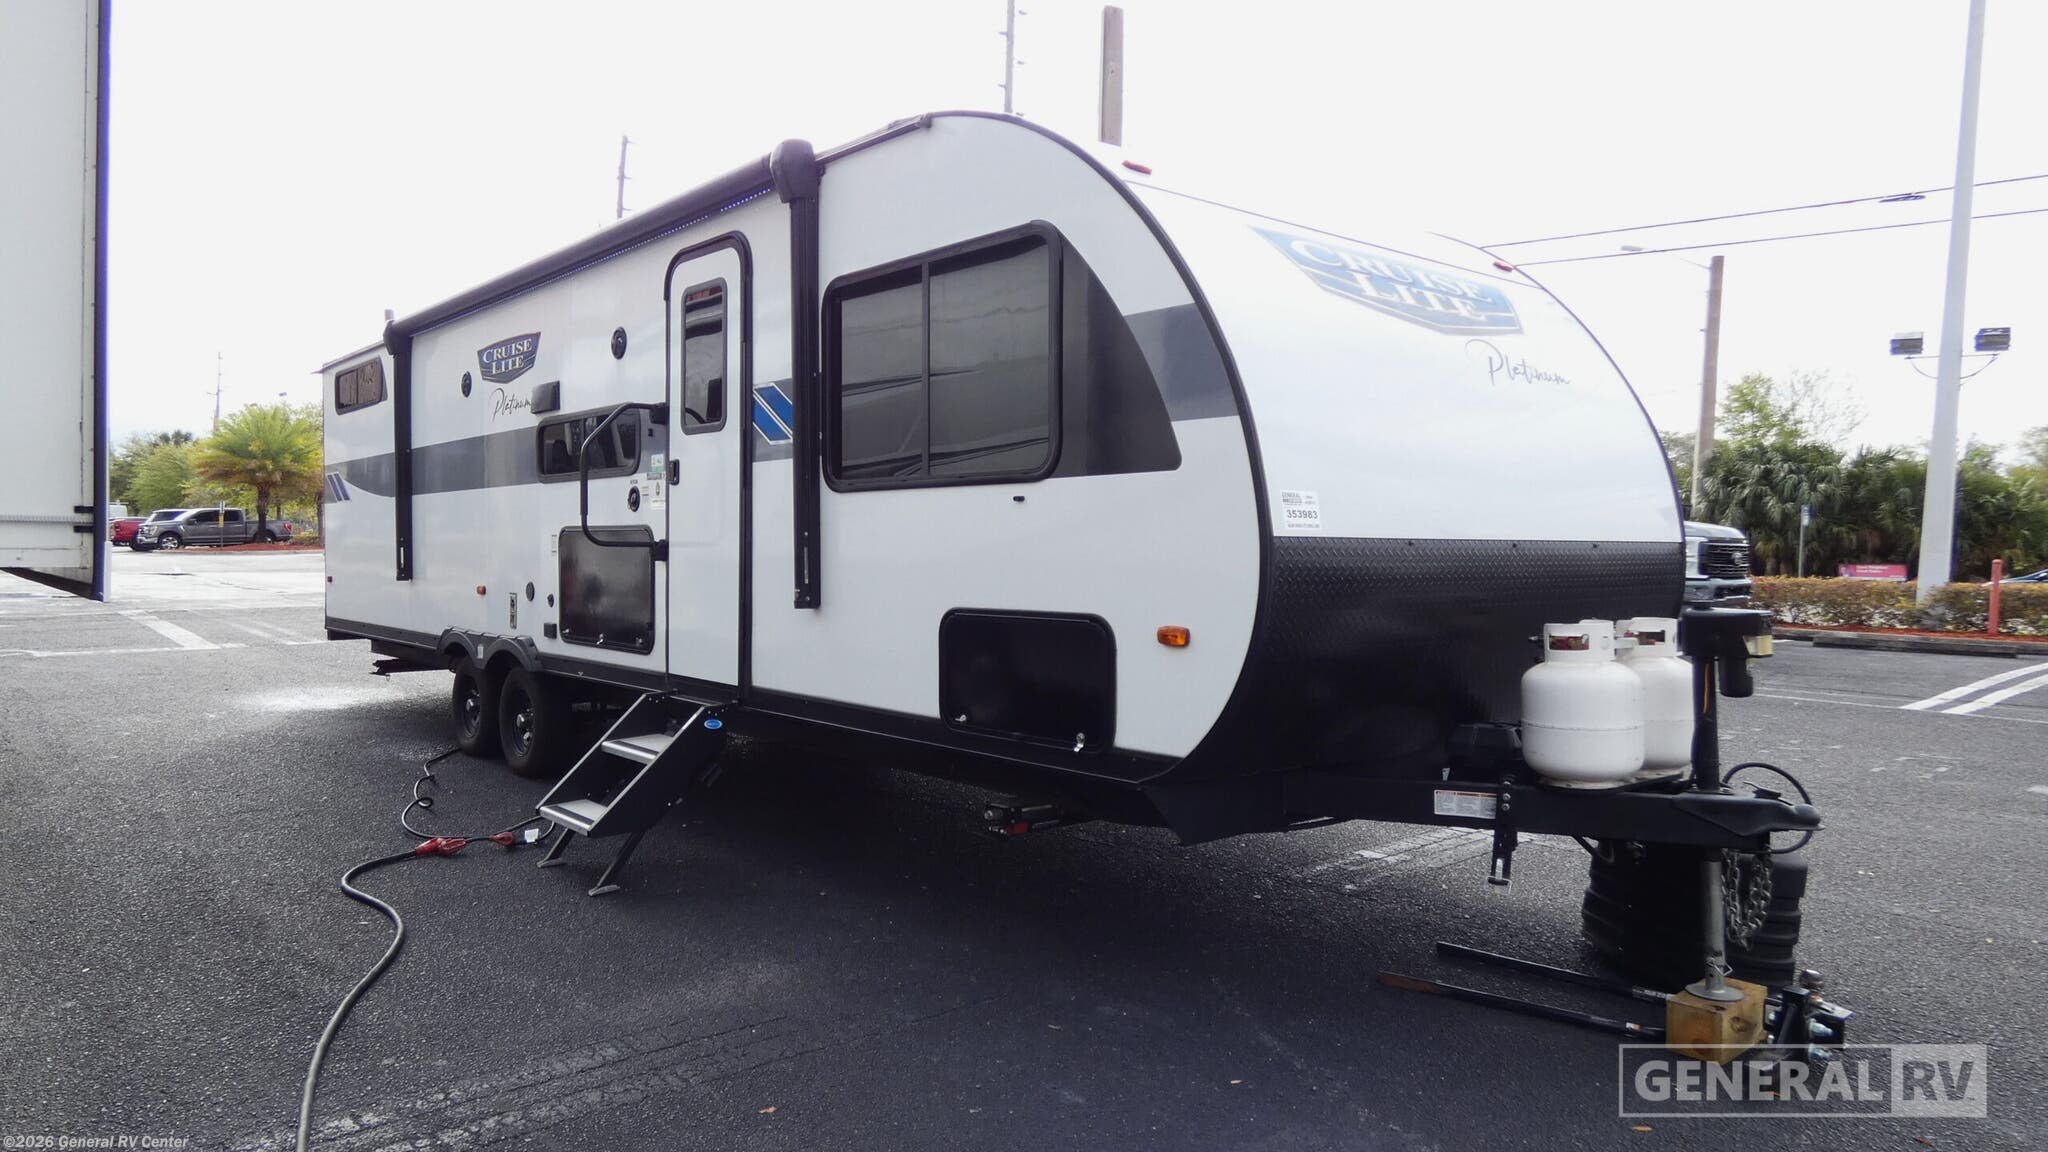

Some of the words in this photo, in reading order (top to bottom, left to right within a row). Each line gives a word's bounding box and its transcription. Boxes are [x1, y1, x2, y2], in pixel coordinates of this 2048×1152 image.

[1290, 240, 1497, 301] CRUISE
[1354, 274, 1488, 321] LITE
[483, 339, 532, 363] CRUISE
[492, 355, 525, 375] LITE
[1464, 339, 1570, 385] Platinum
[488, 387, 531, 423] Platinum
[1286, 509, 1318, 519] 353983
